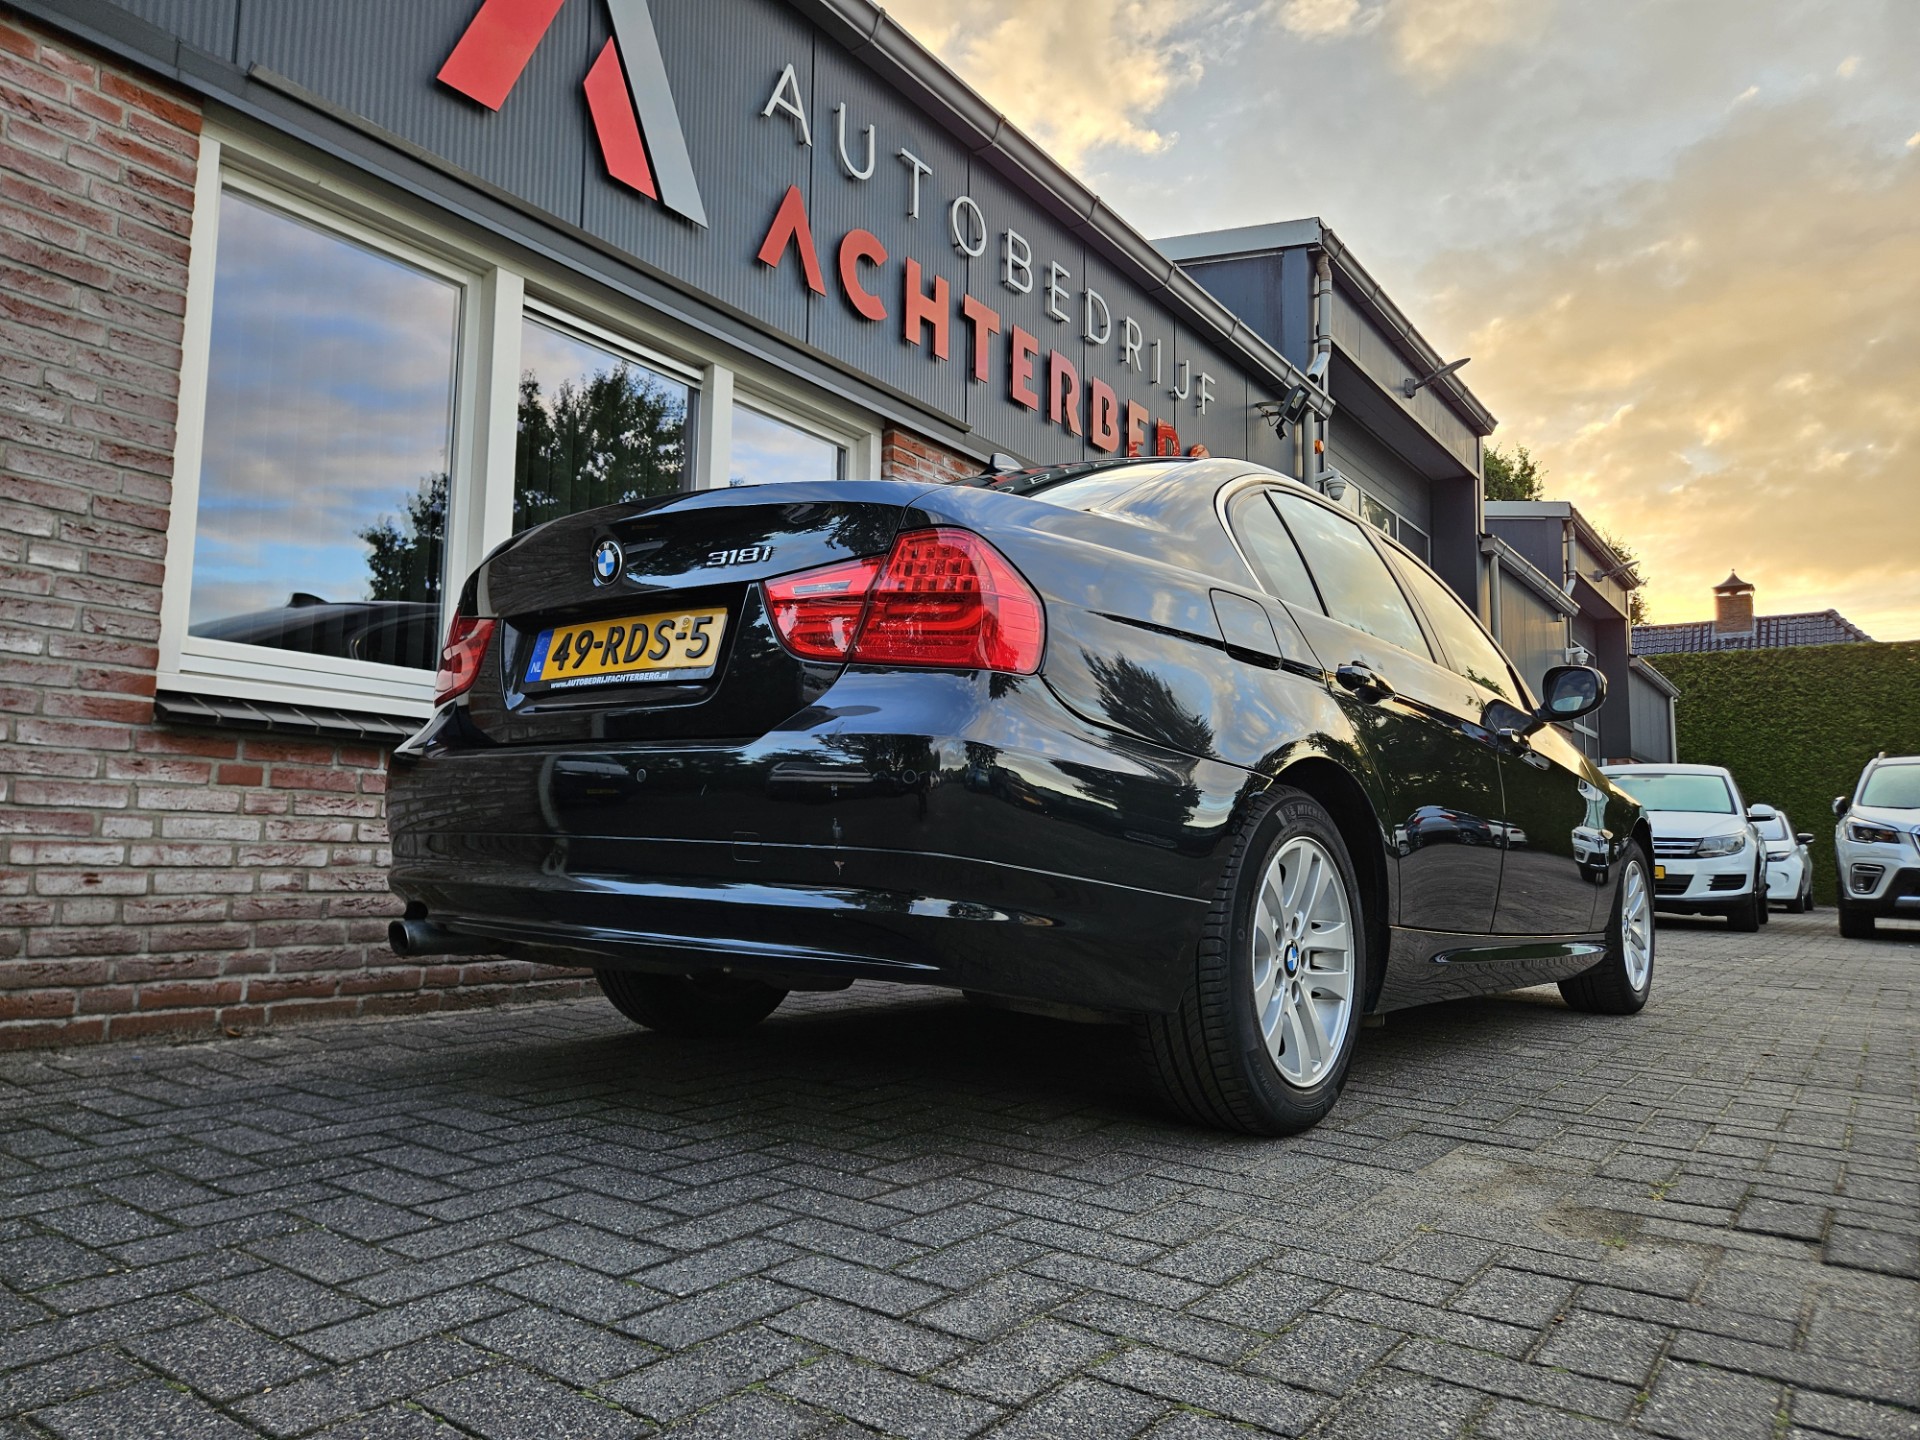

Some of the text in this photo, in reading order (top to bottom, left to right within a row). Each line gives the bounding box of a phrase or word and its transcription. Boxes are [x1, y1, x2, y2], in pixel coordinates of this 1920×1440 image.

[761, 63, 1216, 415] AUTOBEDRIJF
[757, 185, 1211, 458] ACHTERBER
[706, 546, 773, 567] 318i
[551, 616, 713, 670] 49-RDS-5
[529, 660, 541, 674] NL
[550, 671, 669, 689] www.AUTOBEDRIJFACHTERBERG.nl
